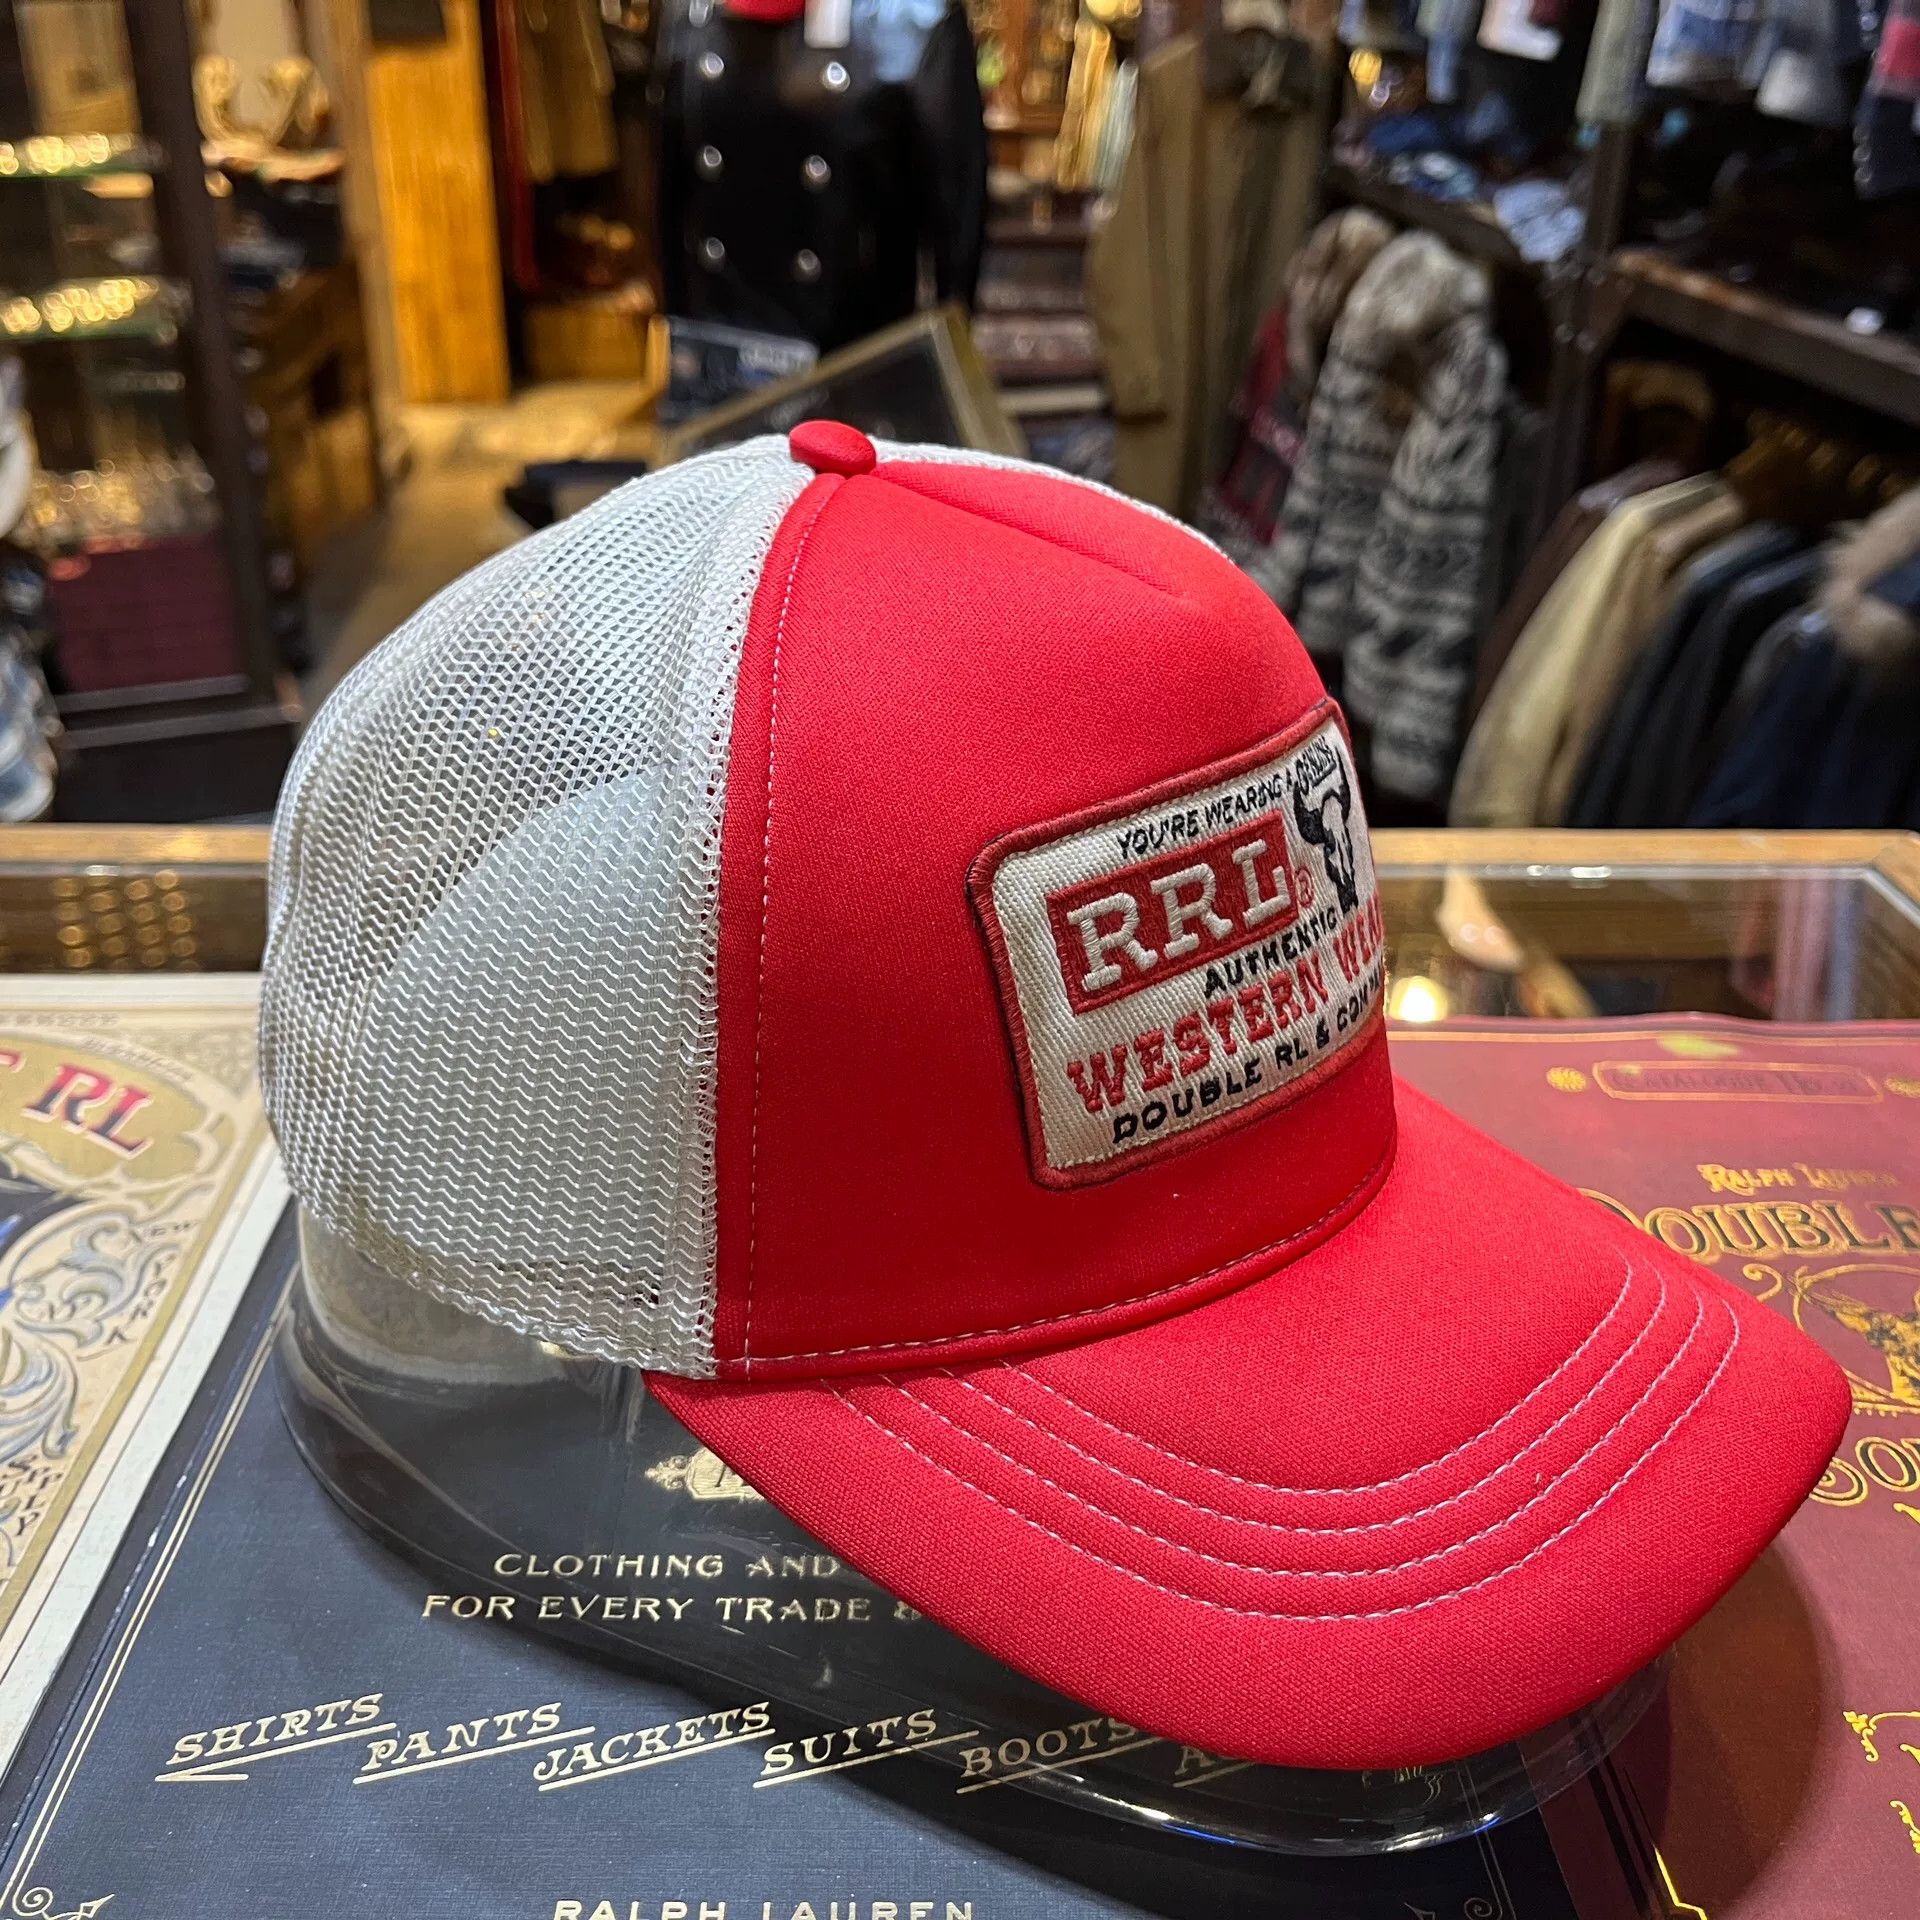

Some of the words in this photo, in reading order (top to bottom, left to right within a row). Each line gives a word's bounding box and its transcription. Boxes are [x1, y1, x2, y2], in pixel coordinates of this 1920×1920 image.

[1117, 809, 1199, 859] YOU'RE
[1204, 774, 1283, 827] WEARING
[1066, 839, 1291, 993] RRL
[1203, 906, 1337, 999] AUTHENTIC
[1066, 951, 1329, 1113] WESTERN
[20, 1062, 155, 1161] RL
[1112, 1058, 1263, 1144] DOUBLE
[1275, 1037, 1309, 1070] RL
[1315, 1016, 1330, 1050] &
[1577, 1188, 1920, 1263] OUBLE
[494, 1553, 724, 1579] CLOTHING
[745, 1553, 841, 1578] AND
[421, 1594, 515, 1620] FOR
[537, 1595, 694, 1622] EVERY
[715, 1597, 872, 1623] TRADE
[166, 1693, 384, 1766] SHIRTS
[359, 1702, 563, 1771] PANTS
[532, 1701, 772, 1782] JACKETS
[762, 1708, 937, 1777] SUITS
[958, 1717, 1137, 1778] BOOTS
